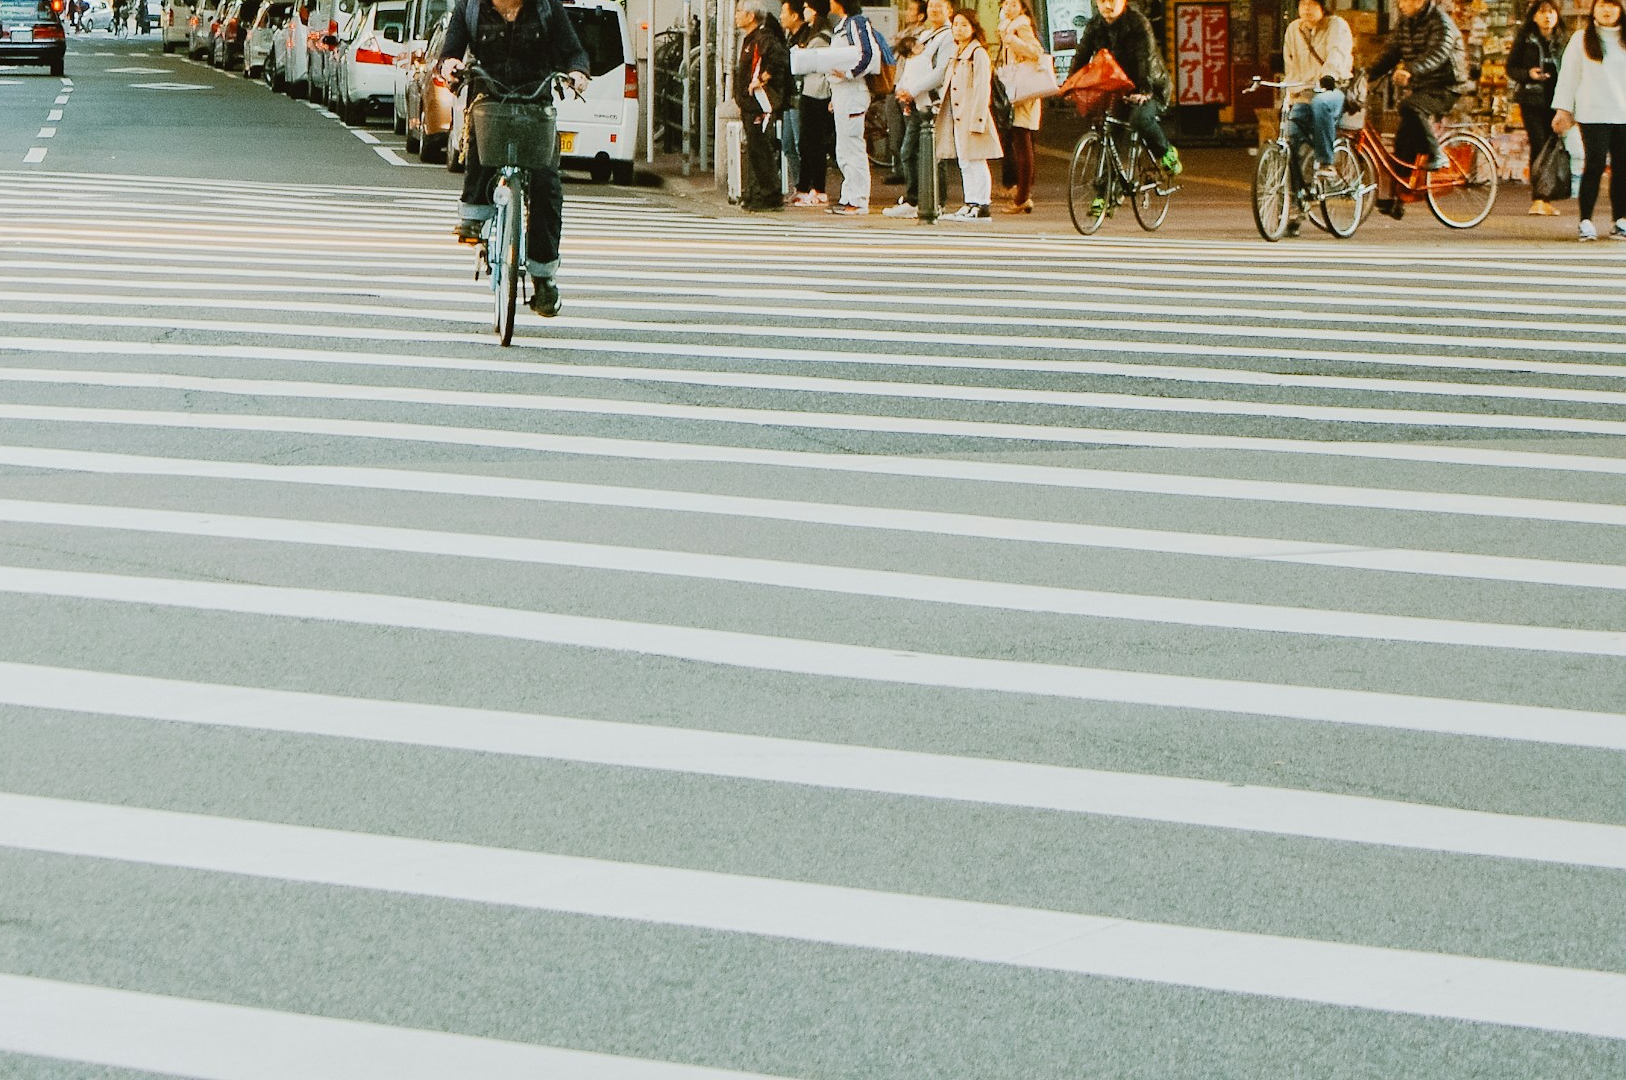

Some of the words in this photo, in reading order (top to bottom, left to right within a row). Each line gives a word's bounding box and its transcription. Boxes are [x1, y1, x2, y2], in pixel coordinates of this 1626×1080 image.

[1203, 8, 1226, 103] テレビゲーム
